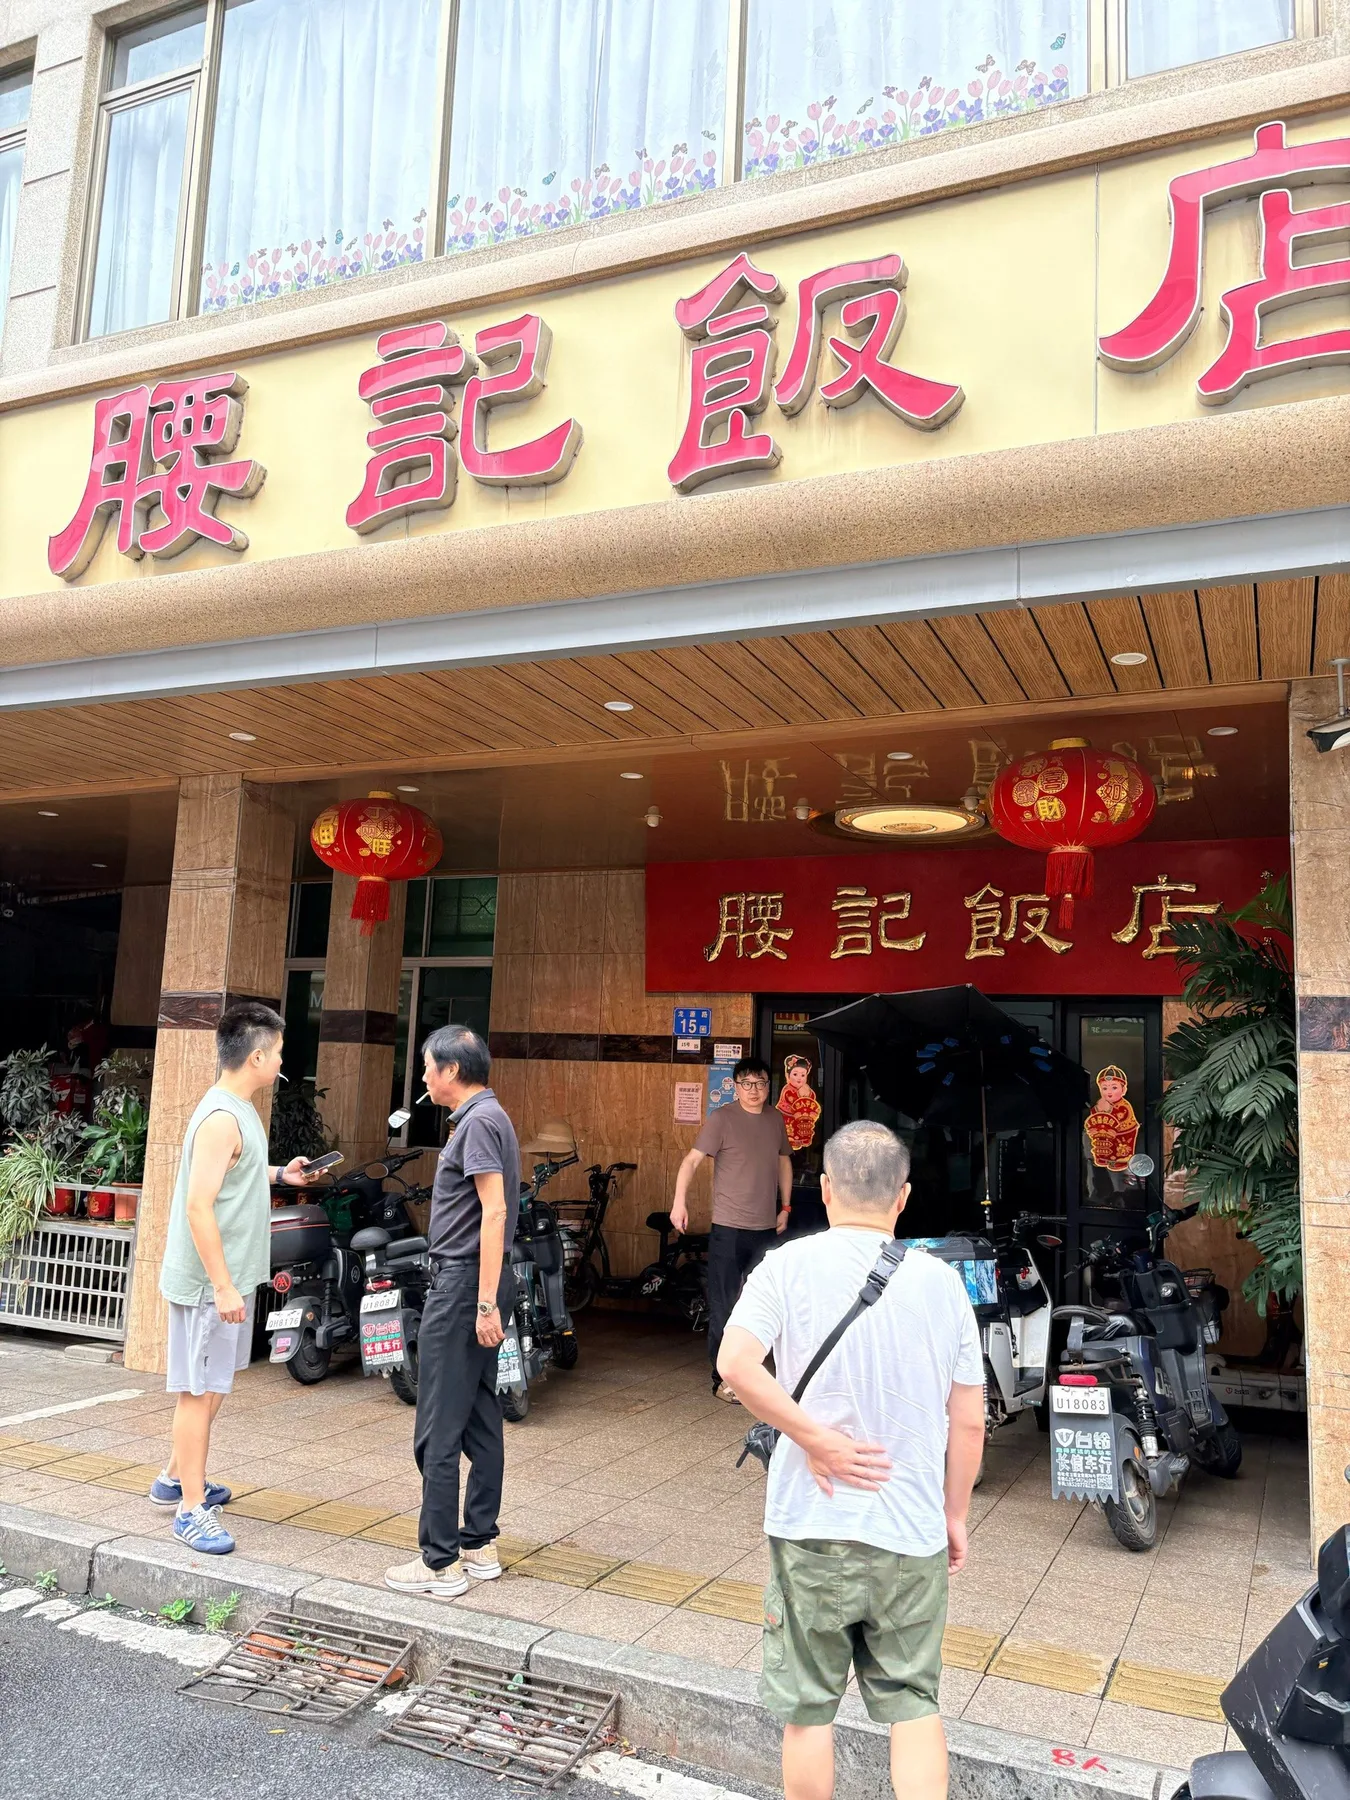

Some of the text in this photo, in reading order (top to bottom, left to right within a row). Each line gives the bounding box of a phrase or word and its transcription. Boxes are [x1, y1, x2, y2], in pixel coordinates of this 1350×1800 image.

[47, 121, 1350, 584] 腰記飯店
[703, 873, 1223, 962] 腰記飯店
[680, 1018, 697, 1034] 15
[363, 1298, 396, 1310] U18087
[365, 1340, 401, 1354] 长信车行
[1056, 1397, 1106, 1411] U18083
[1056, 1453, 1112, 1474] 长信车行
